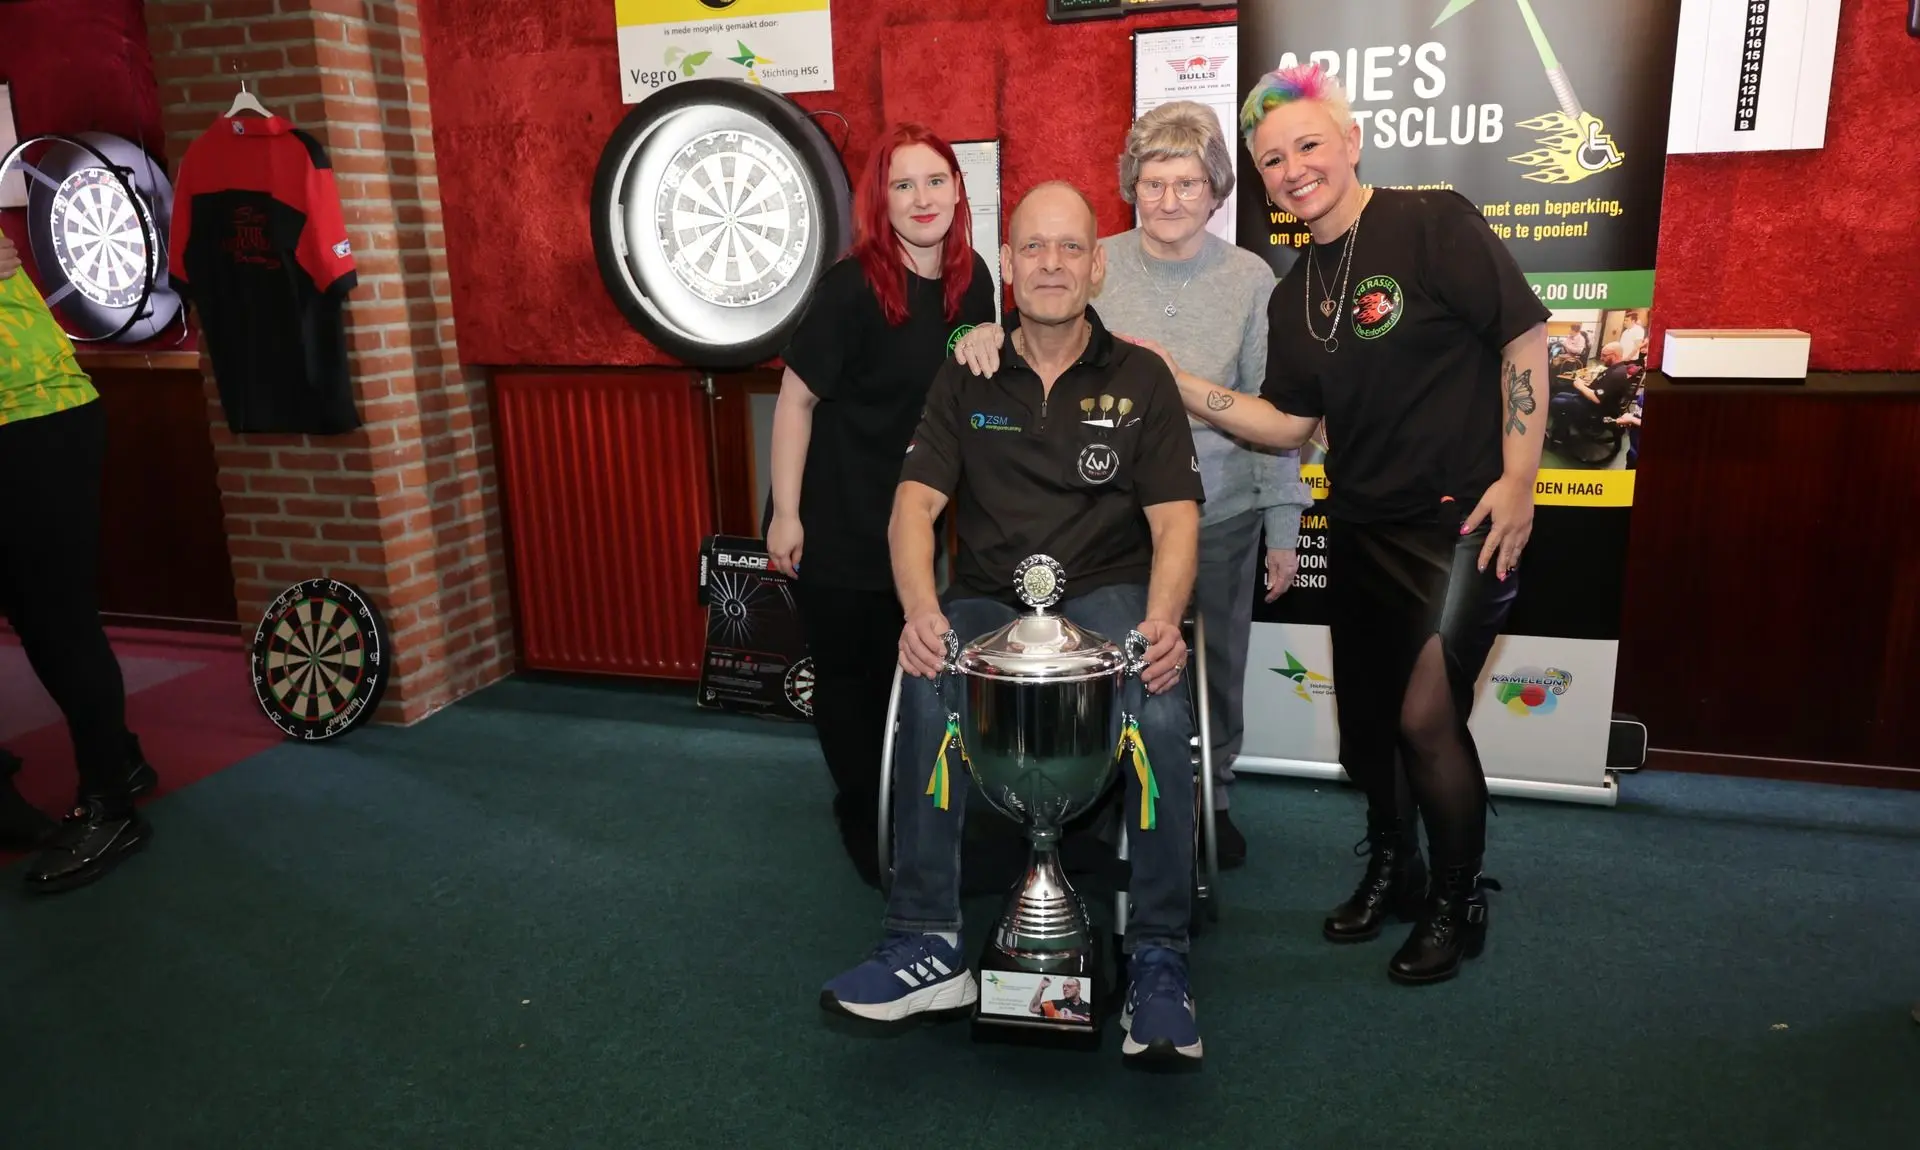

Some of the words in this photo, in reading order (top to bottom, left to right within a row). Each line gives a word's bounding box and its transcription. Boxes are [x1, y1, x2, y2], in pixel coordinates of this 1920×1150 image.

[1750, 4, 1765, 13] 19
[1749, 15, 1764, 25] 18
[671, 26, 691, 35] mede
[693, 23, 724, 34] mogelijk
[725, 20, 757, 32] gemaakt
[759, 19, 779, 29] door:
[1748, 27, 1763, 36] 17
[1746, 39, 1762, 49] 16
[1745, 51, 1760, 60] 15
[762, 67, 799, 78] Stichting
[801, 66, 819, 75] HSG
[1744, 62, 1759, 72] 14
[630, 68, 677, 88] Vegro
[1179, 71, 1216, 80] BULL'S
[1742, 74, 1758, 84] 13
[1741, 85, 1757, 95] 12
[1740, 97, 1754, 107] 11
[1739, 108, 1753, 118] 10
[1740, 120, 1749, 129] B
[1483, 201, 1510, 217] met
[1514, 202, 1540, 215] een
[1544, 198, 1623, 217] beperking,
[1270, 233, 1290, 245] om
[1294, 232, 1312, 247] ge
[1516, 223, 1529, 238] te
[1534, 221, 1589, 241] gooien!
[1366, 279, 1394, 292] RASSEL
[1573, 283, 1608, 299] UUR
[986, 415, 1008, 425] ZSM
[1536, 482, 1562, 495] DEN
[1567, 484, 1603, 496] HAAG
[718, 554, 769, 567] BLADE
[1491, 674, 1562, 686] KAMELEON
